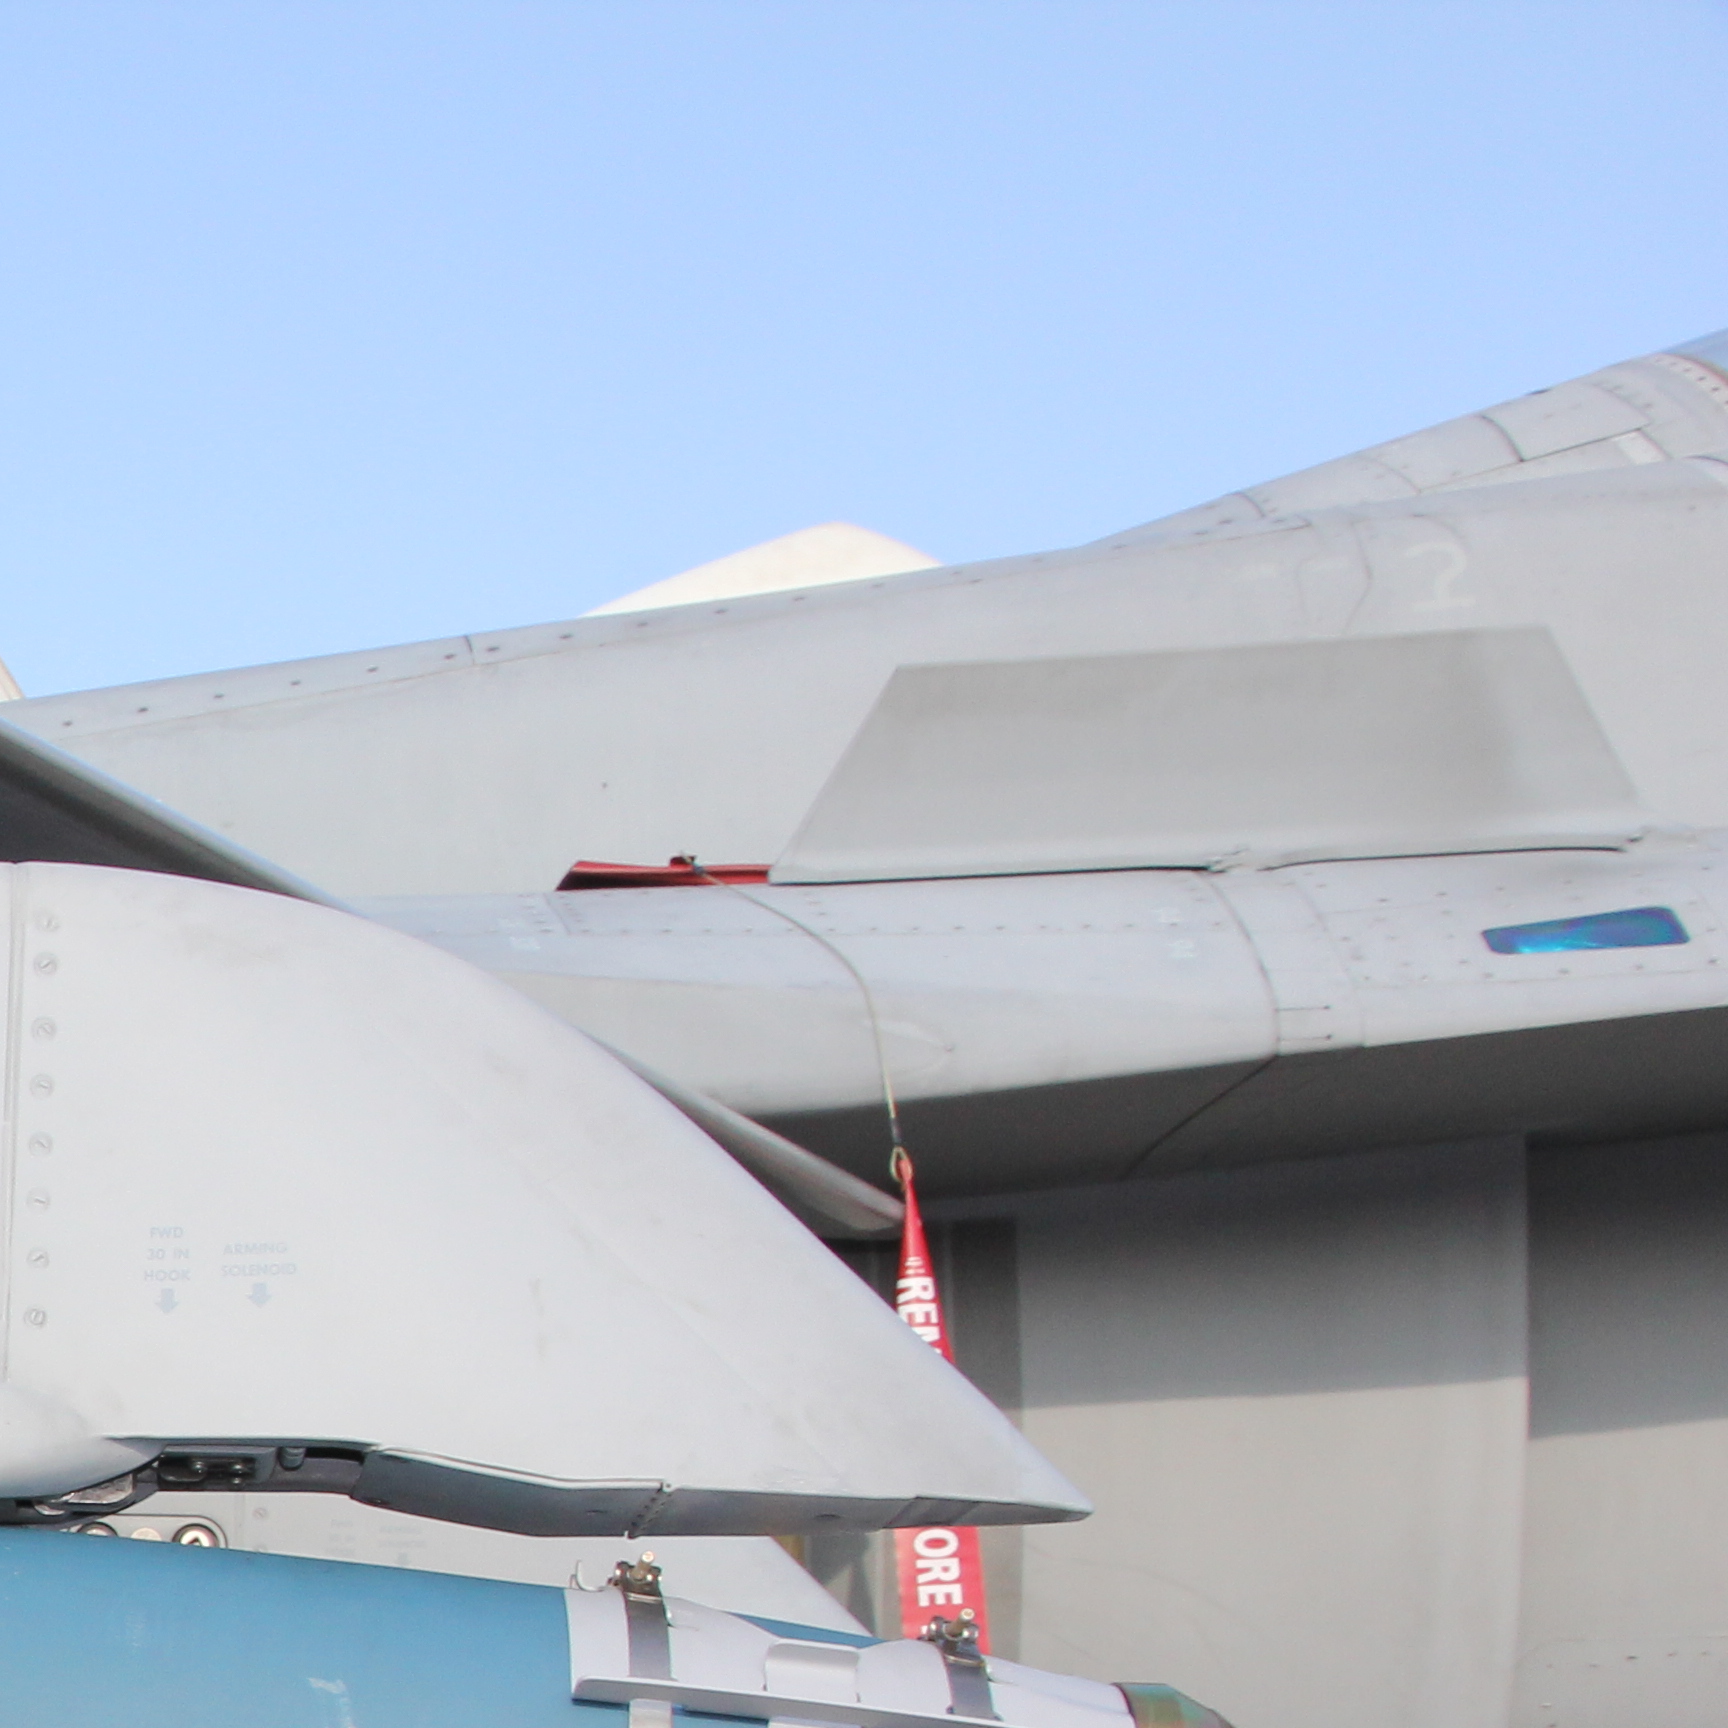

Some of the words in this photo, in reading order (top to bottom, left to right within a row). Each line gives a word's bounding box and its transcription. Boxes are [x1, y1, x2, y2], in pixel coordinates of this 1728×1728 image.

[149, 1227, 185, 1241] FWD
[173, 1247, 190, 1261] IN
[223, 1242, 288, 1256] ARMING
[143, 1268, 192, 1283] HOOK
[221, 1262, 298, 1277] SOLENOID
[914, 1528, 963, 1607] ORE
